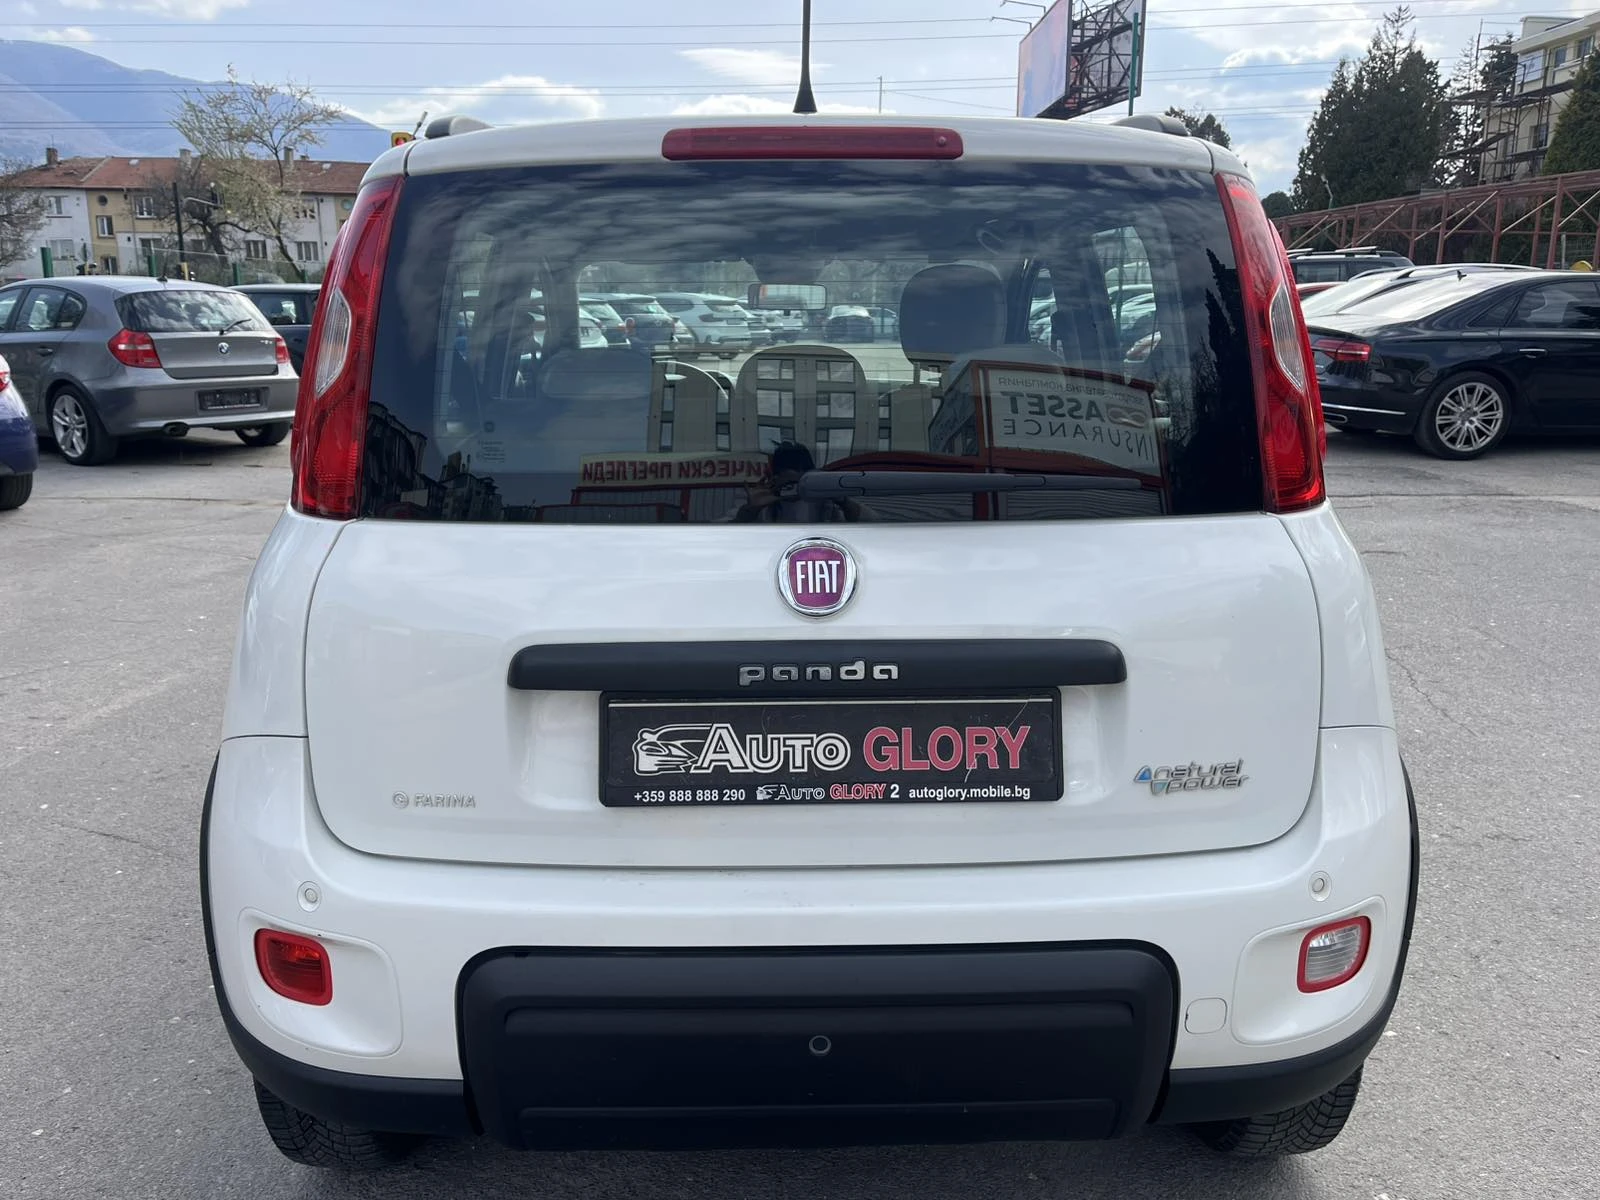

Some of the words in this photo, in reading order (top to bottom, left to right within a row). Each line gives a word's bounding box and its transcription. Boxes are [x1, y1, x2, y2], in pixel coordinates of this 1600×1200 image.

[795, 560, 841, 595] FIAT
[737, 659, 899, 687] panda
[862, 725, 1031, 772] GLORY
[1154, 758, 1243, 778] natural
[829, 783, 887, 800] GLORY
[890, 784, 900, 799] 2
[908, 785, 1031, 801] autoglory.mobile.bg
[1166, 775, 1249, 793] power
[414, 792, 477, 808] FARINA
[634, 789, 665, 803] +359
[669, 789, 692, 802] 888
[696, 789, 719, 802] 888
[722, 788, 746, 802] 290
